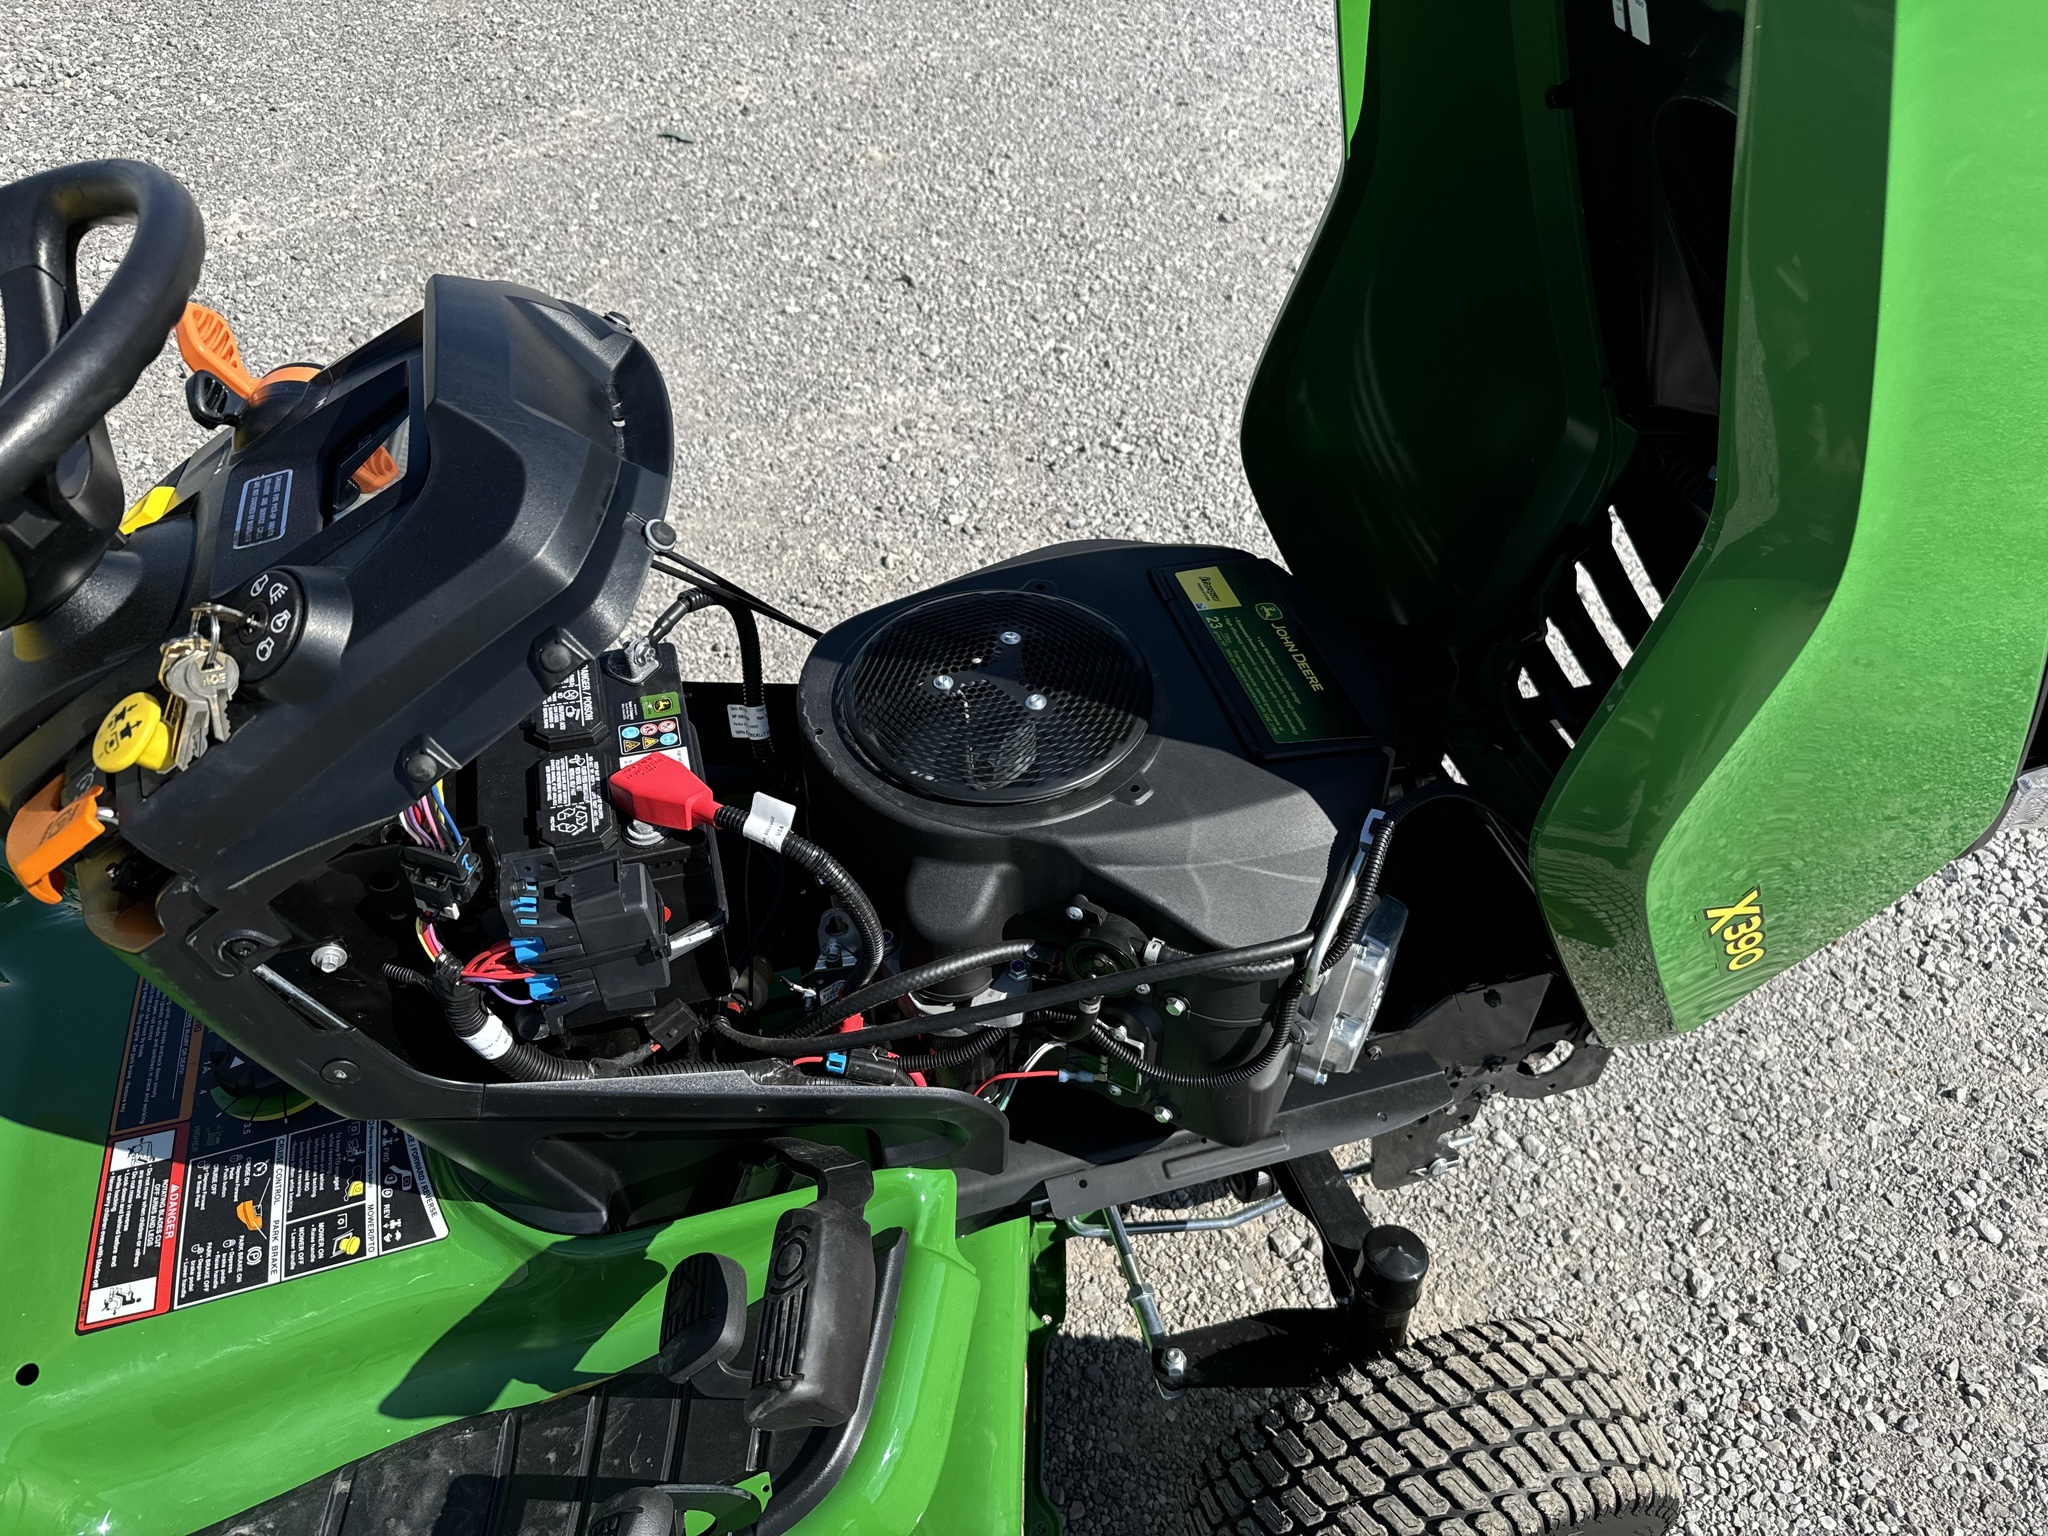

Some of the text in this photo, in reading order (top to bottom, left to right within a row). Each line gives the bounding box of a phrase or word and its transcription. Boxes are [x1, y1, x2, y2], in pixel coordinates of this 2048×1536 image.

[1205, 616, 1223, 629] 23
[1271, 622, 1324, 692] JOHN DEERE
[583, 696, 592, 720] POISON
[1702, 886, 1765, 972] X390
[182, 1029, 190, 1047] INJURY
[180, 1048, 187, 1056] OR
[178, 1056, 186, 1074] DEATH
[150, 1081, 158, 1098] slowly
[138, 1103, 147, 1124] working
[242, 1121, 251, 1134] 3.5
[191, 1125, 201, 1152] HIGHER
[382, 1146, 390, 1163] FWD
[122, 1172, 130, 1187] Look
[146, 1167, 152, 1175] Do
[332, 1165, 340, 1190] engaged
[135, 1179, 143, 1198] around
[243, 1177, 249, 1186] ON
[410, 1148, 425, 1182] FORWARD
[421, 1185, 438, 1217] REVERSE
[103, 1192, 111, 1207] carry
[110, 1189, 120, 1212] backing
[120, 1187, 128, 1202] down
[150, 1197, 158, 1214] ARMS
[153, 1178, 168, 1248] ROTATING BLADES CUT
[270, 1138, 284, 1275] CRUISE CONTROL PARK BRAKE
[382, 1203, 390, 1220] REV
[100, 1207, 109, 1230] children
[115, 1214, 124, 1235] behind
[123, 1210, 131, 1231] reverse
[148, 1214, 156, 1228] AND
[165, 1192, 179, 1240] DANGER
[136, 1216, 145, 1240] children
[146, 1229, 154, 1246] LEGS
[366, 1203, 374, 1253] MOWER/PTO
[96, 1244, 104, 1258] with
[112, 1234, 120, 1254] before
[317, 1247, 323, 1259] ON
[133, 1247, 141, 1267] others
[92, 1258, 101, 1278] blades
[236, 1272, 241, 1283] ON
